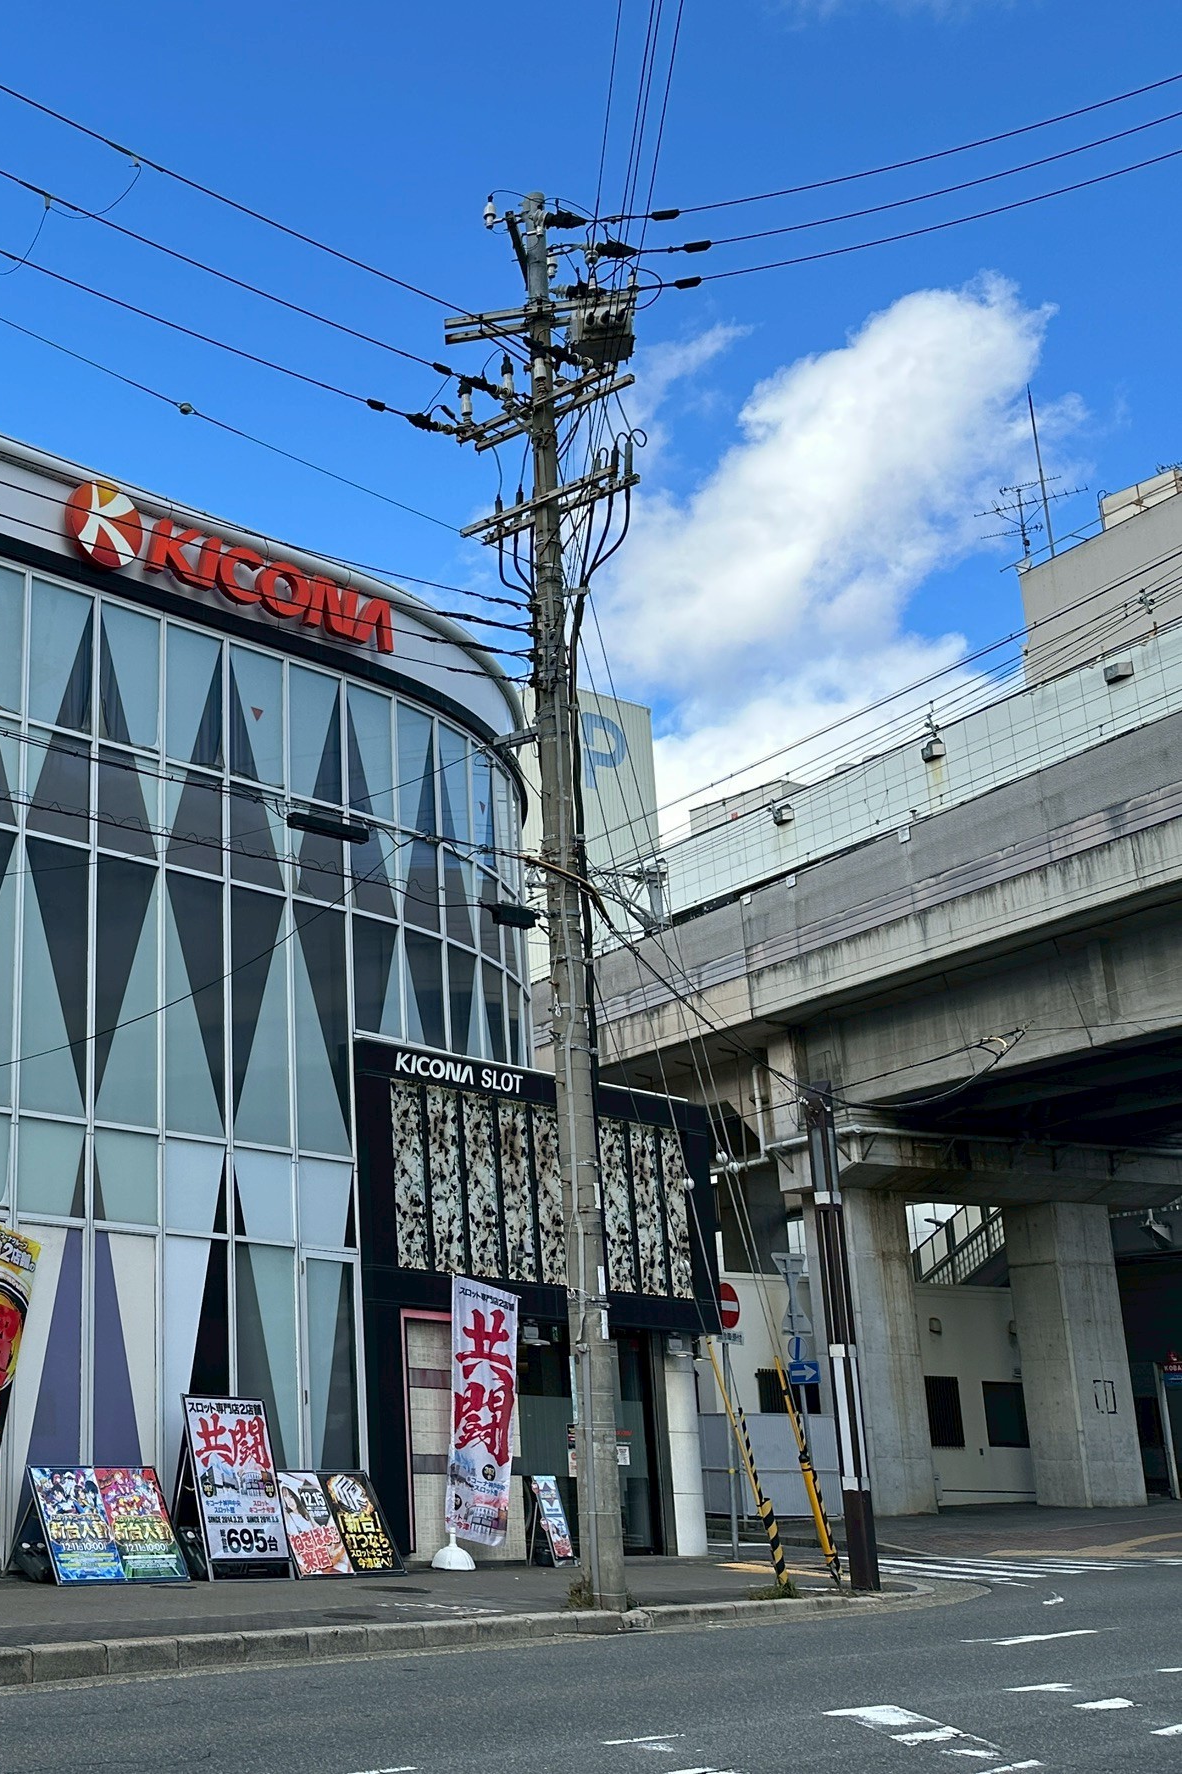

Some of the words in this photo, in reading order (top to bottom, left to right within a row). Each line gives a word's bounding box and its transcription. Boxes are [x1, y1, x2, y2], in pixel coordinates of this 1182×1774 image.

[143, 517, 394, 653] KICONA
[581, 711, 626, 790] P
[395, 1052, 474, 1085] KICONA
[481, 1068, 523, 1094] SLOT
[1163, 1364, 1182, 1372] KOBA
[188, 1402, 263, 1416] スロット専門店2店舗
[195, 1413, 271, 1470] 共闘
[227, 1528, 278, 1553] 695台
[345, 1532, 390, 1549] 打つなら
[300, 1547, 333, 1572] 来店
